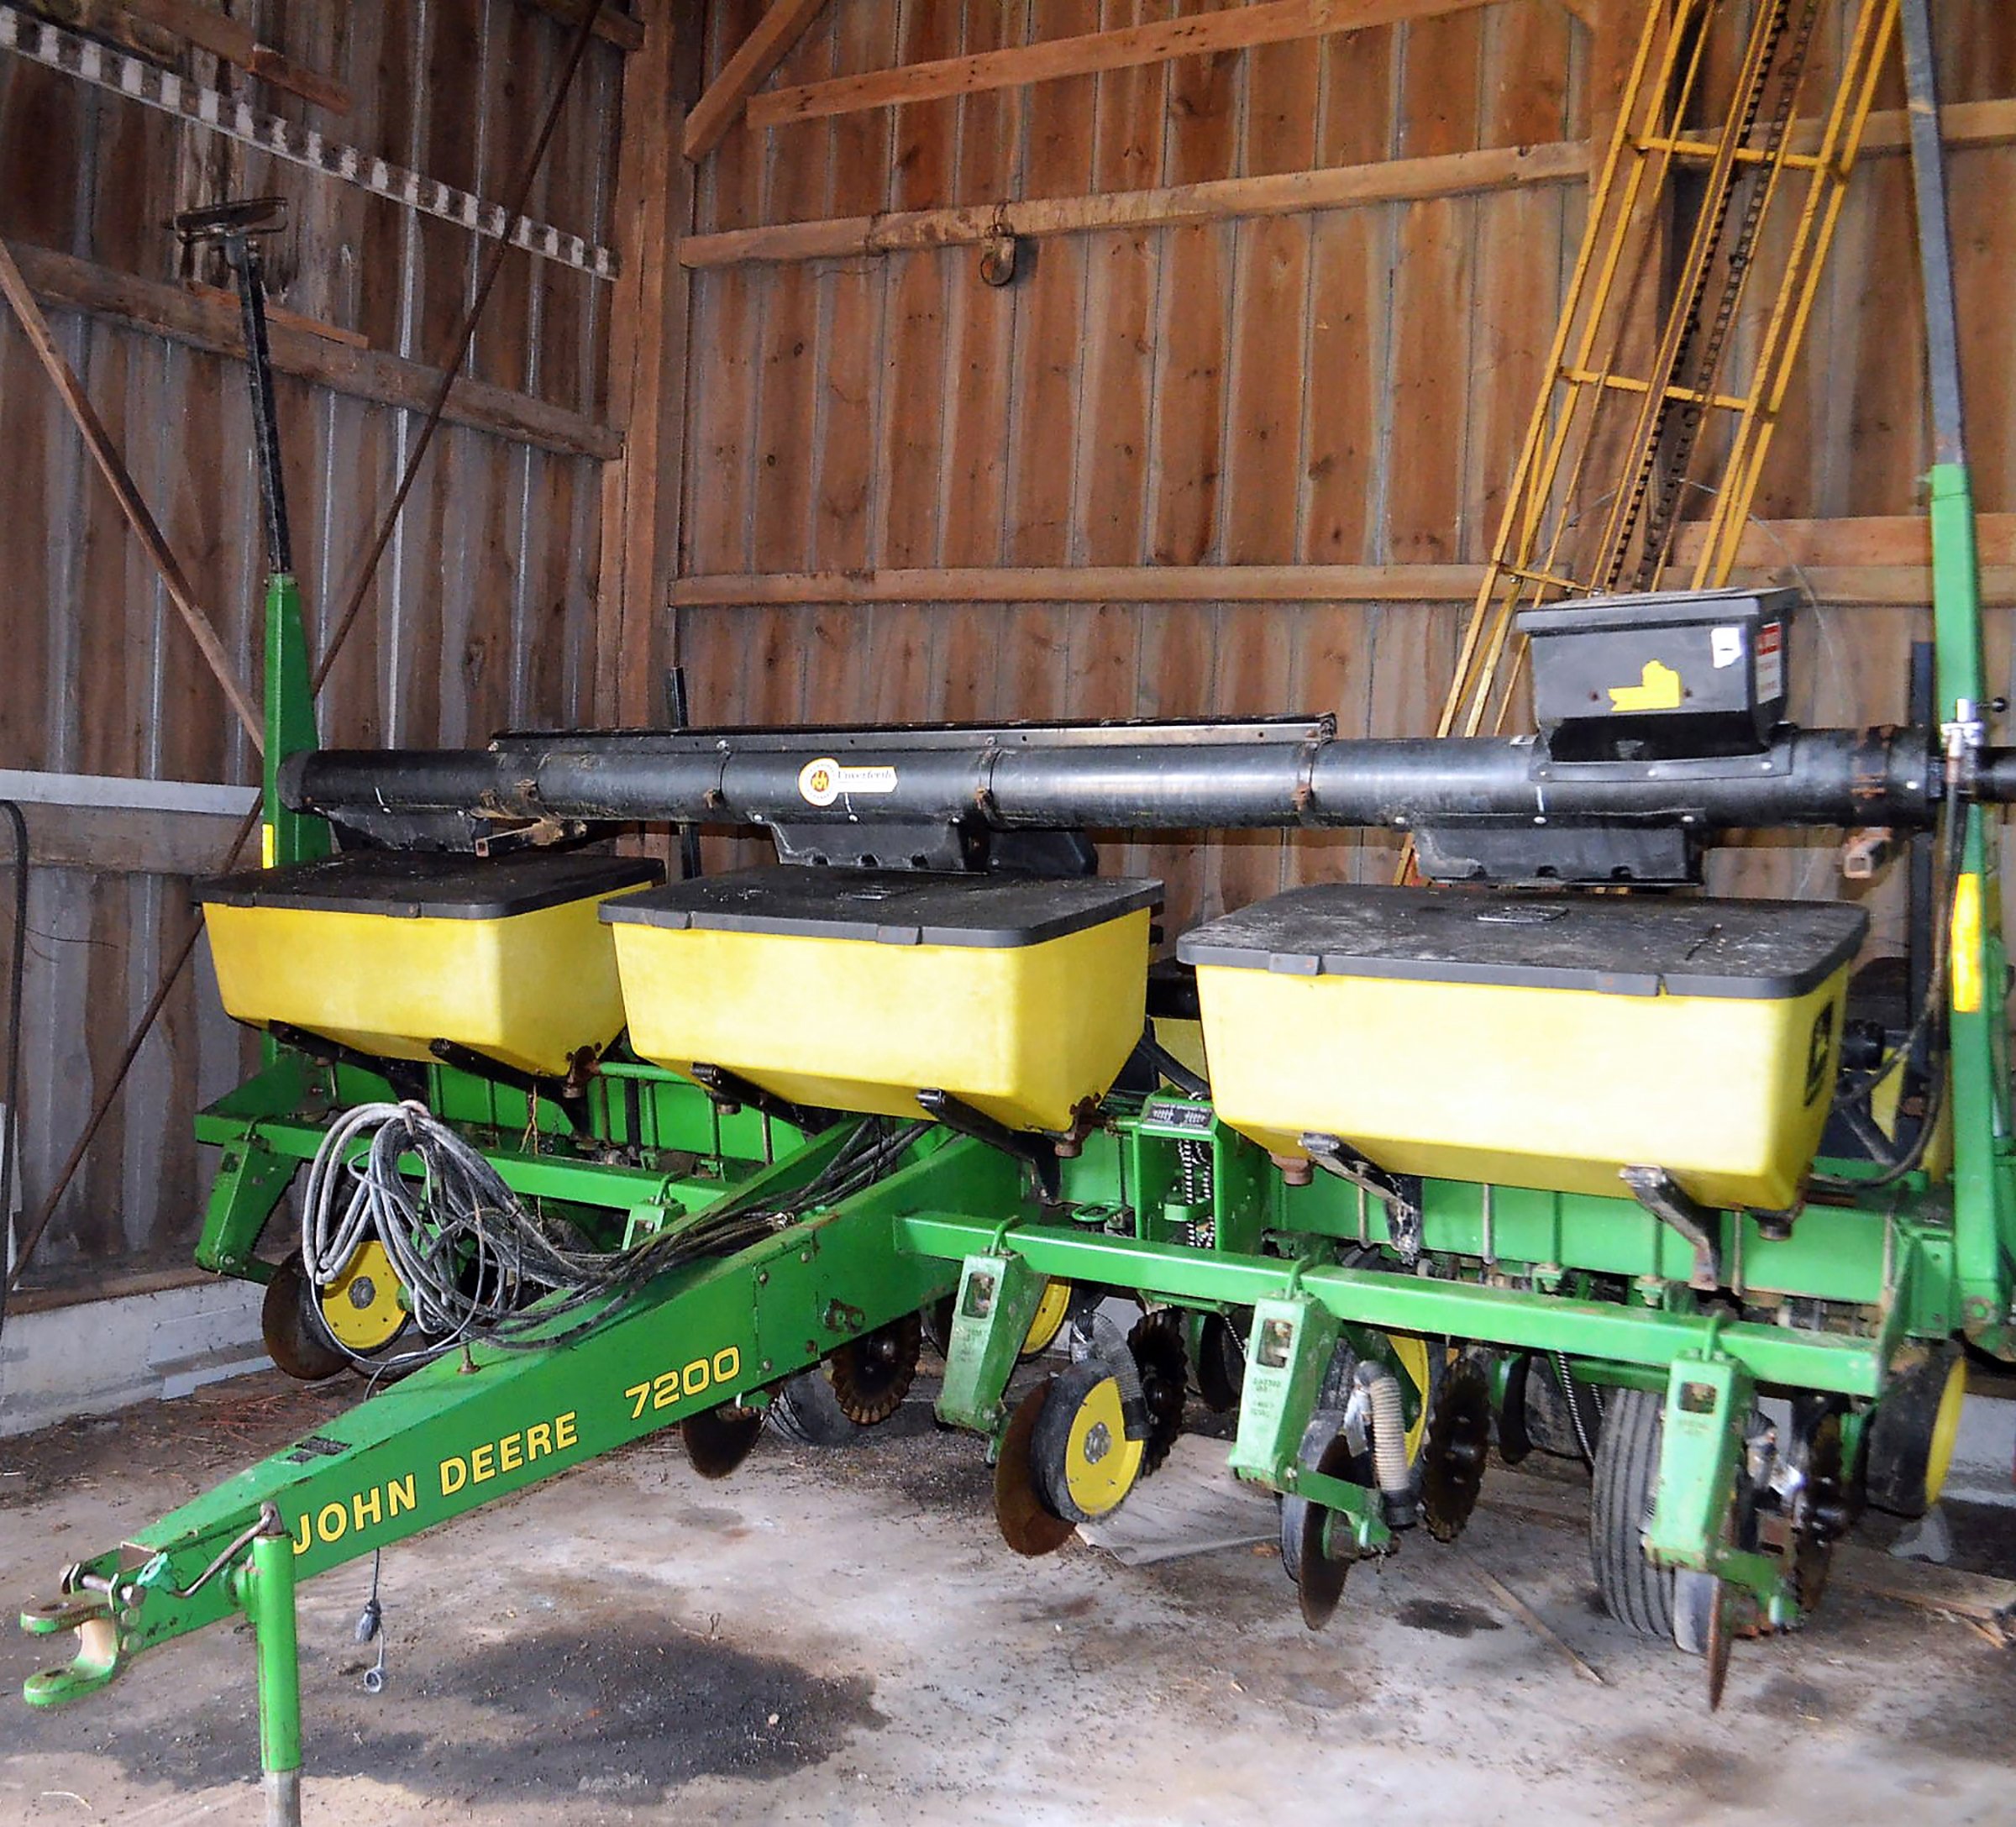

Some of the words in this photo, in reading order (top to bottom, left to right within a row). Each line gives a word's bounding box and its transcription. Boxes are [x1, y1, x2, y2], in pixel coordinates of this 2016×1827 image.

[292, 1473, 417, 1555] JOHN
[439, 1410, 579, 1496] DEERE
[625, 1346, 741, 1420] 7200
